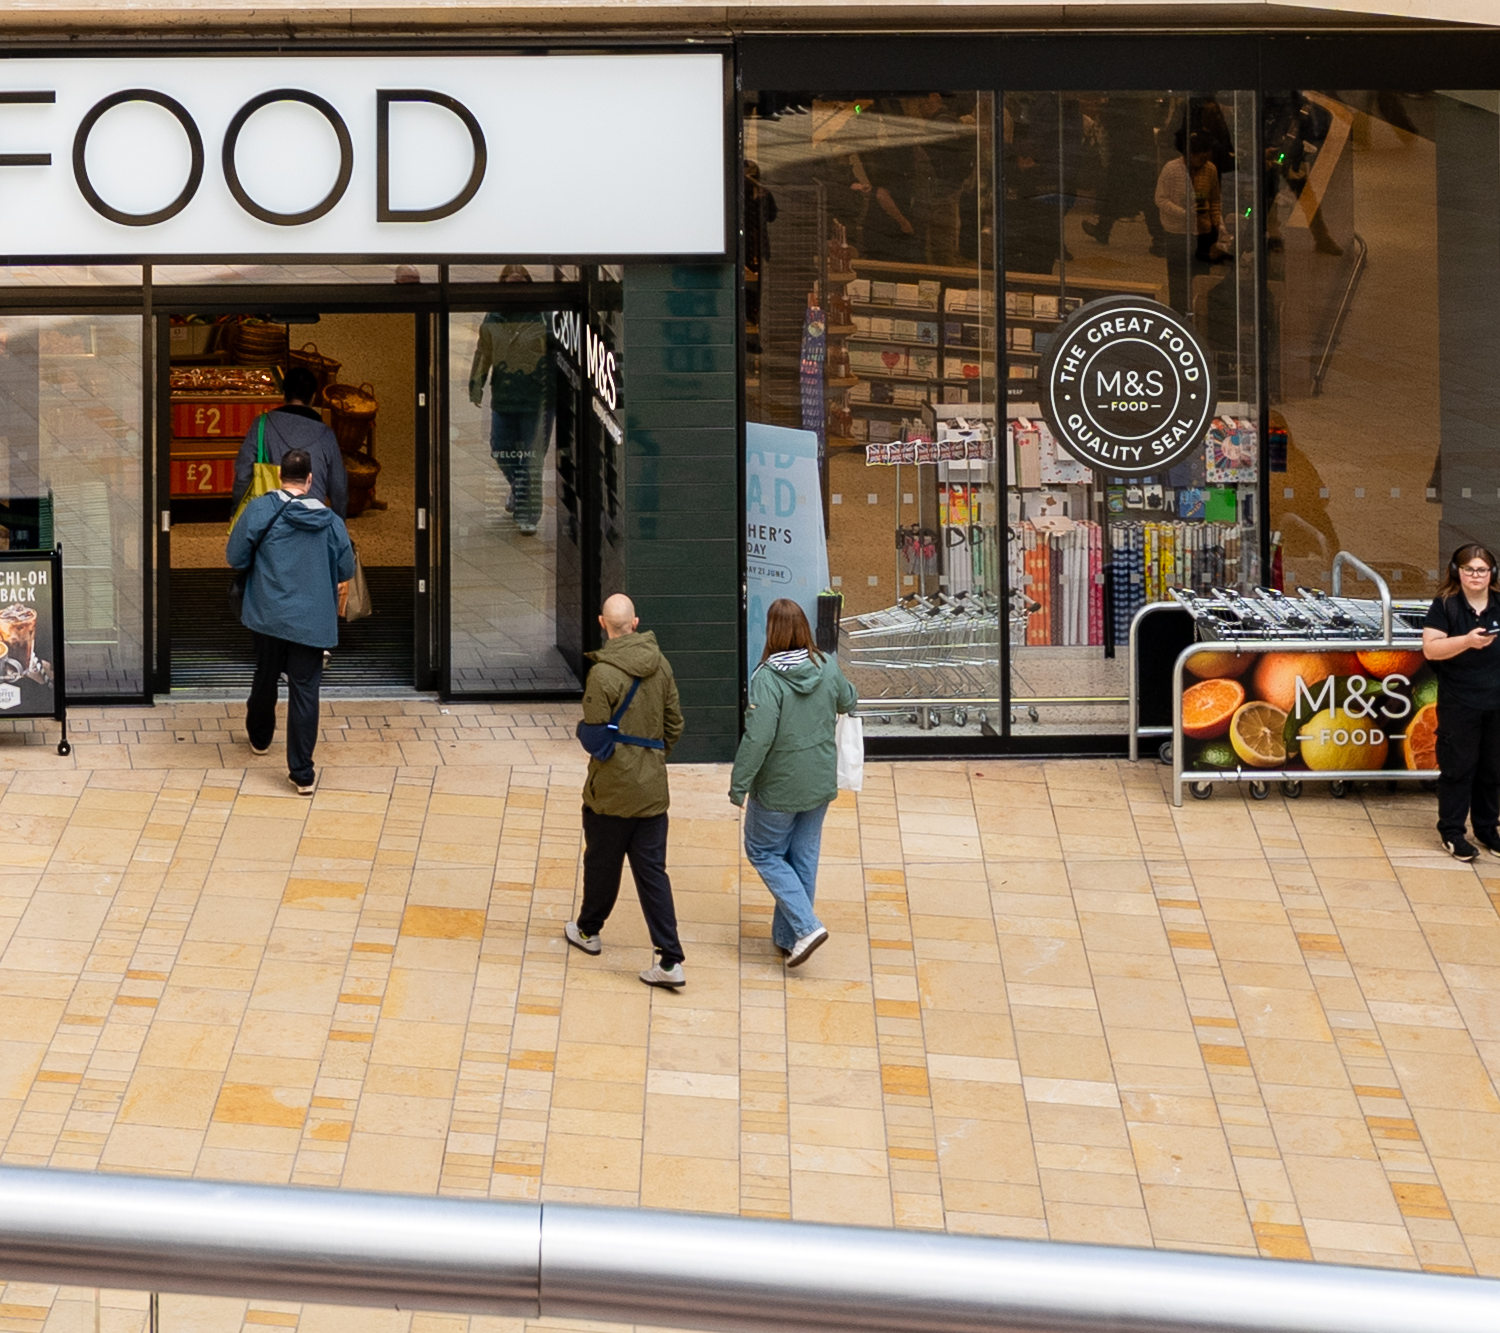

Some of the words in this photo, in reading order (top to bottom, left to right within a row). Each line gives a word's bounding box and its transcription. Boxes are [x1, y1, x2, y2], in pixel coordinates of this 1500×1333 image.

[1060, 344, 1086, 383] THE
[1087, 317, 1154, 343] GREAT
[1159, 327, 1200, 381] FOOD
[586, 323, 617, 410] M&S
[1097, 370, 1163, 396] M&S
[1111, 401, 1148, 411] FOOD
[195, 408, 220, 434] £2
[1068, 414, 1142, 461] QUALITY
[1151, 418, 1193, 455] SEAL
[493, 450, 537, 459] WELCOME
[187, 463, 212, 490] £2
[748, 523, 792, 544] HER'S
[747, 566, 757, 575] AY
[758, 567, 765, 576] 21
[766, 569, 785, 578] JUNE
[0, 587, 36, 603] BACK
[1295, 674, 1411, 719] M&S
[1320, 729, 1384, 745] FOOD
